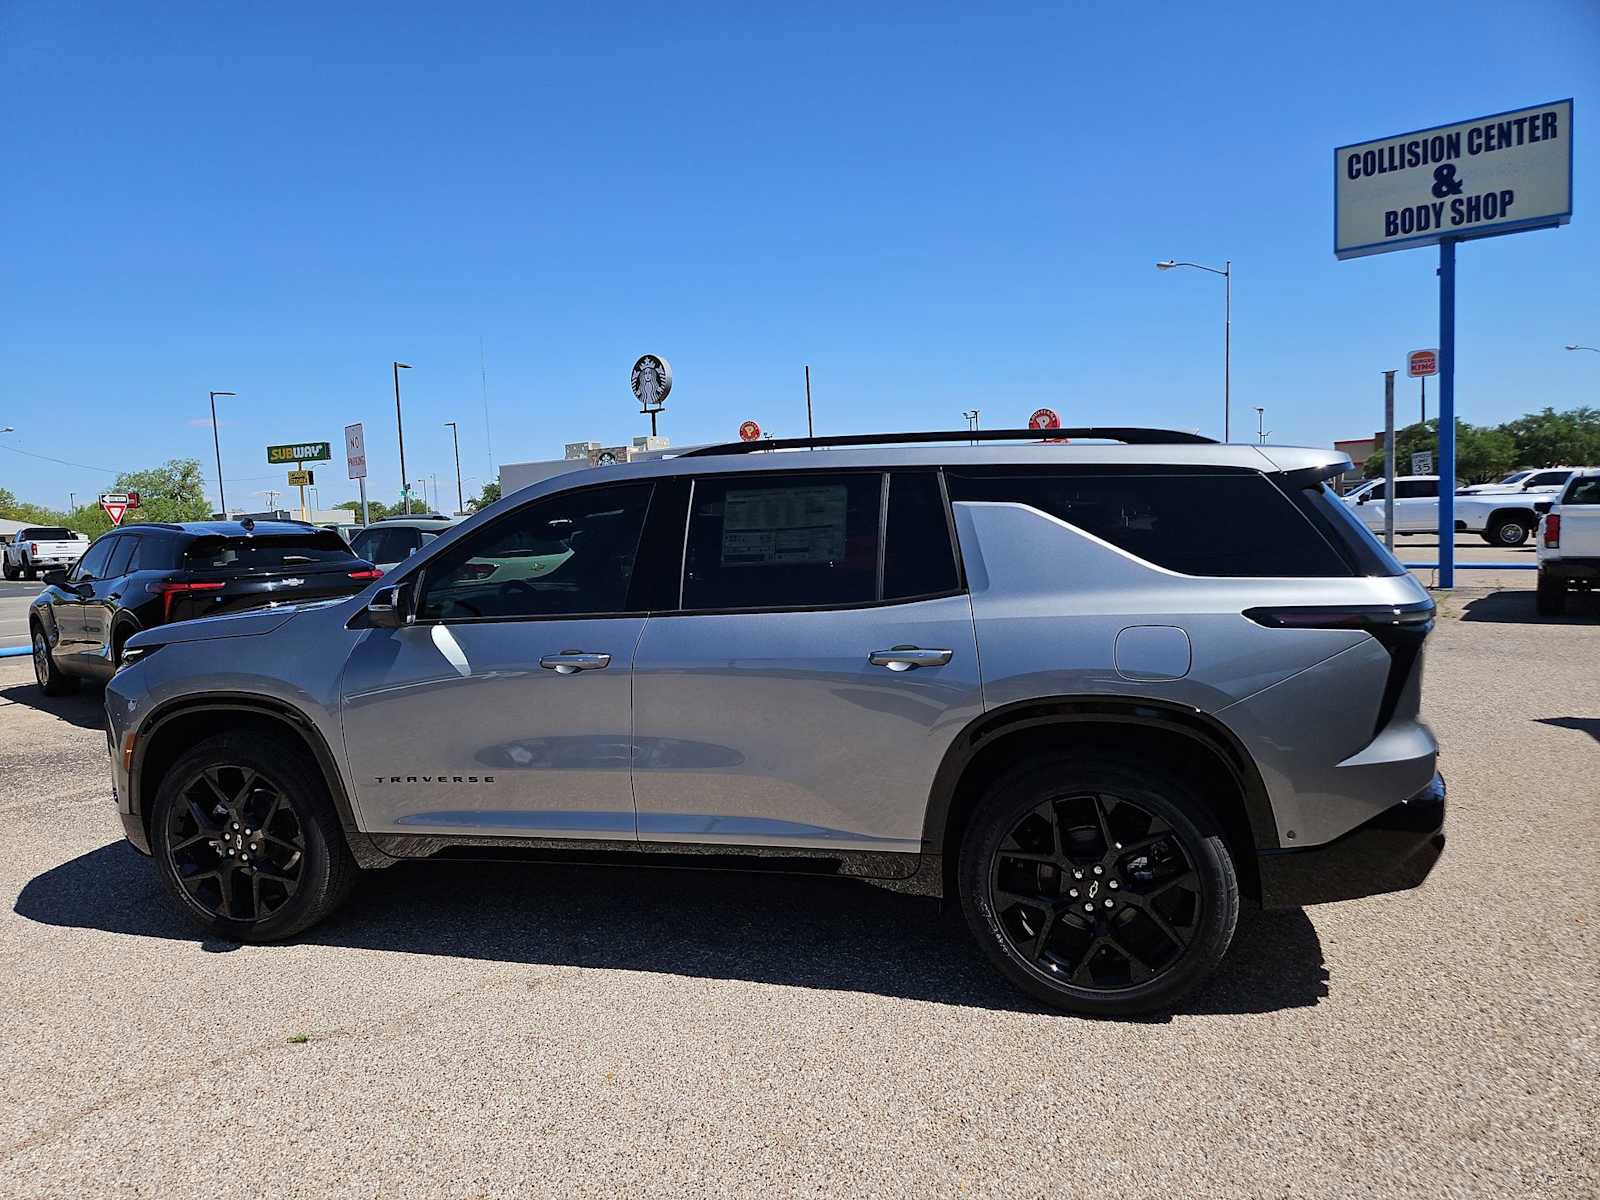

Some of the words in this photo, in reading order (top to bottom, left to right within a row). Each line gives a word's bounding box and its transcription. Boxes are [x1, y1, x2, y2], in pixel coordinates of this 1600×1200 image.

[1347, 131, 1461, 180] COLLISION
[1467, 111, 1558, 156] CENTER
[1431, 163, 1463, 198] &
[1384, 201, 1445, 237] BODY
[1450, 190, 1515, 225] SHOP
[350, 436, 360, 449] NO
[271, 444, 322, 461] SUBWAY
[1415, 463, 1431, 473] 35
[375, 776, 495, 784] TRAVERSE
